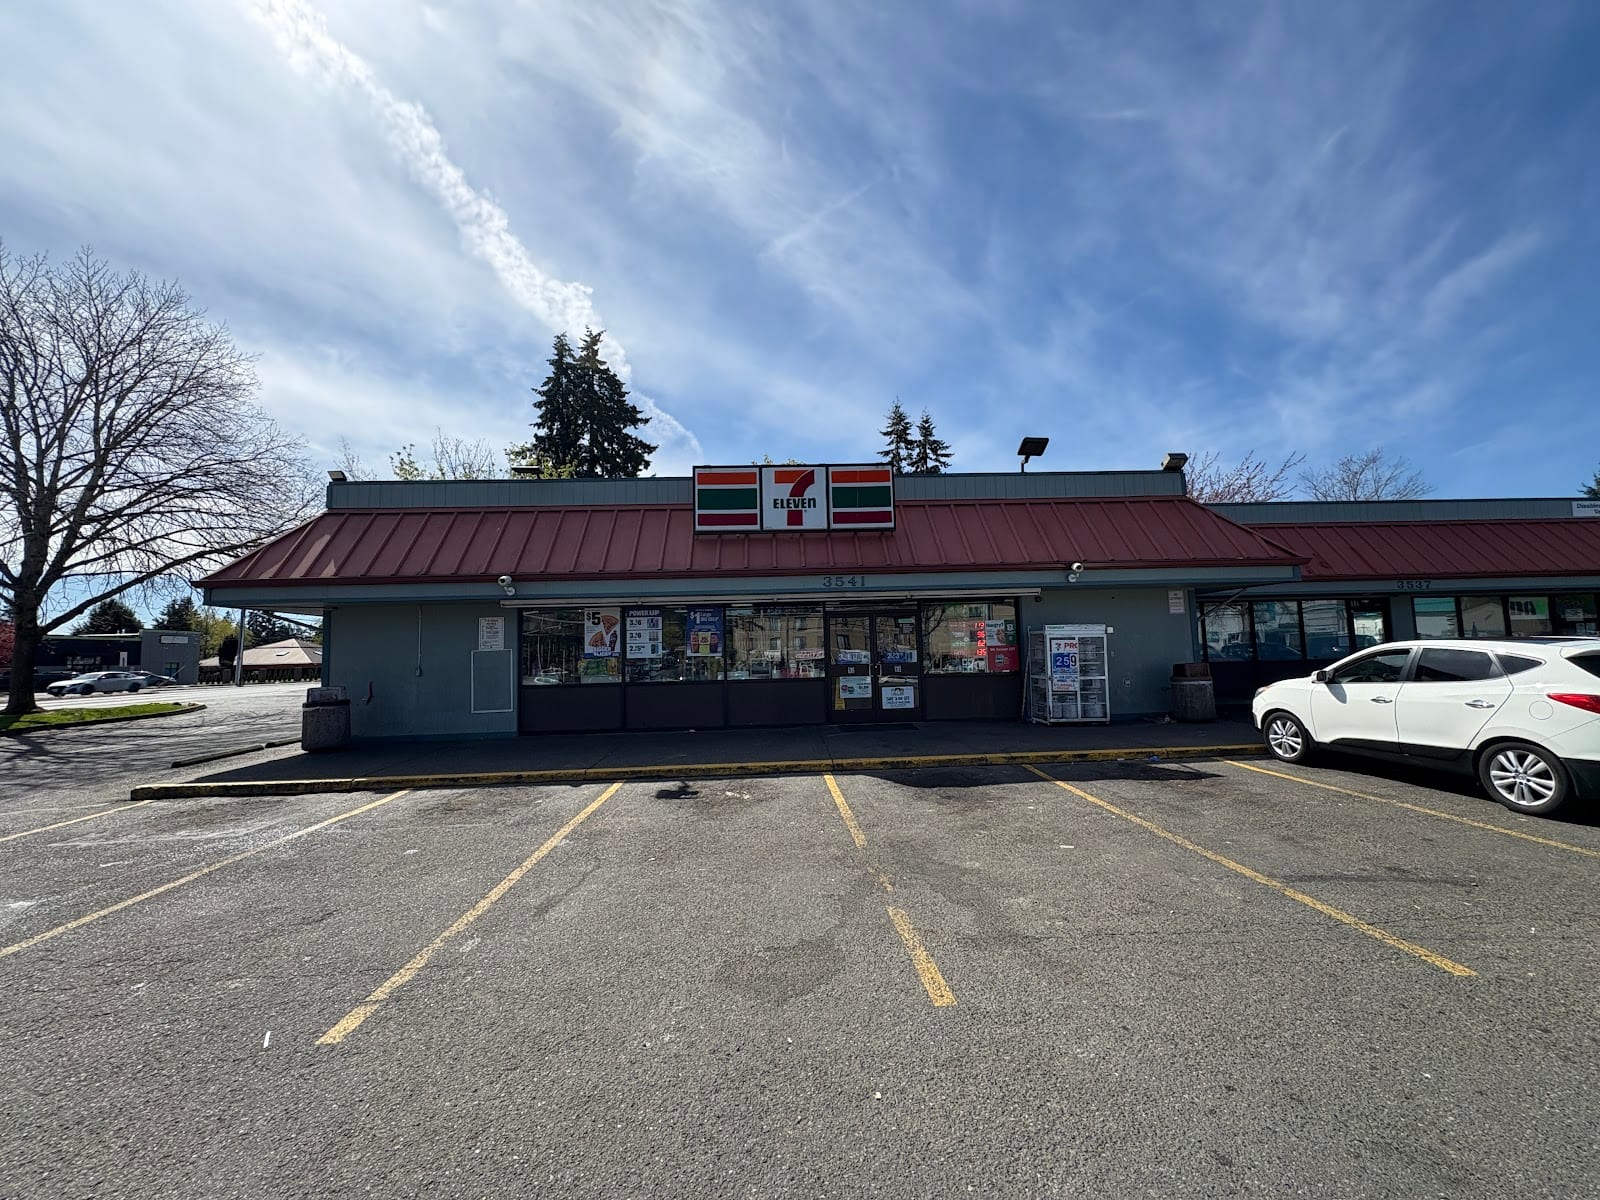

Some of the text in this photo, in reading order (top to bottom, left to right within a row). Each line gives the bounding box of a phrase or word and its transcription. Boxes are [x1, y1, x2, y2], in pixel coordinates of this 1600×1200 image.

[775, 469, 815, 526] 7
[823, 576, 865, 587] 3541
[1397, 580, 1431, 590] 3537
[586, 612, 601, 625] $5
[690, 611, 701, 624] $1
